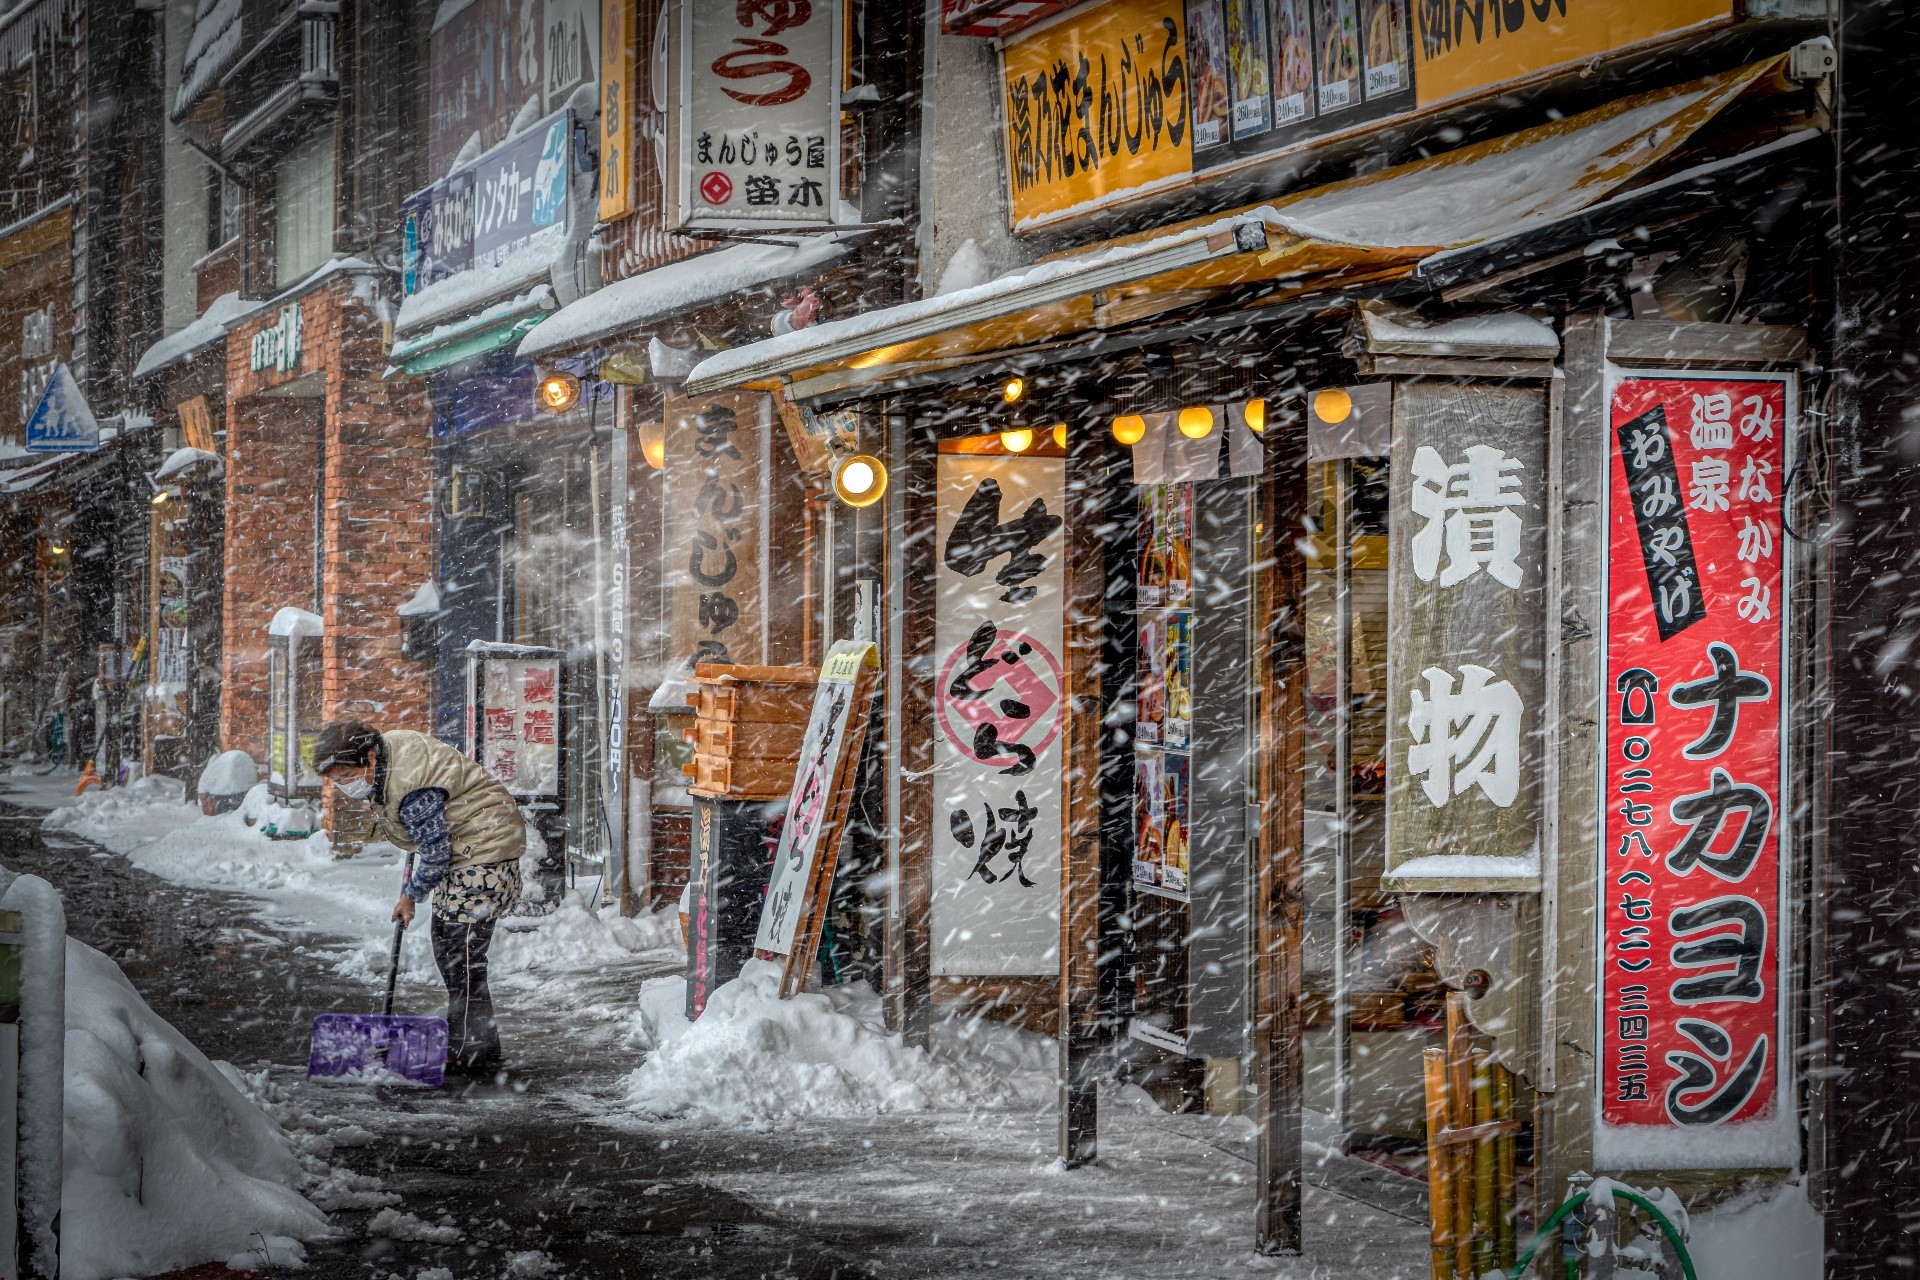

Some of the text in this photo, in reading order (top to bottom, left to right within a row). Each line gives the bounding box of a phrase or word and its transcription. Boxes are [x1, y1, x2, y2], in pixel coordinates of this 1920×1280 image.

[550, 20, 579, 93] 20km
[697, 131, 825, 168] まんじゅう屋
[744, 174, 823, 207] 笛木
[1631, 422, 1693, 624] おみやげ
[1689, 393, 1733, 512] 温泉
[1739, 395, 1773, 624] みなかみ
[944, 477, 1063, 888] 生どら焼
[1407, 444, 1527, 808] 漬物
